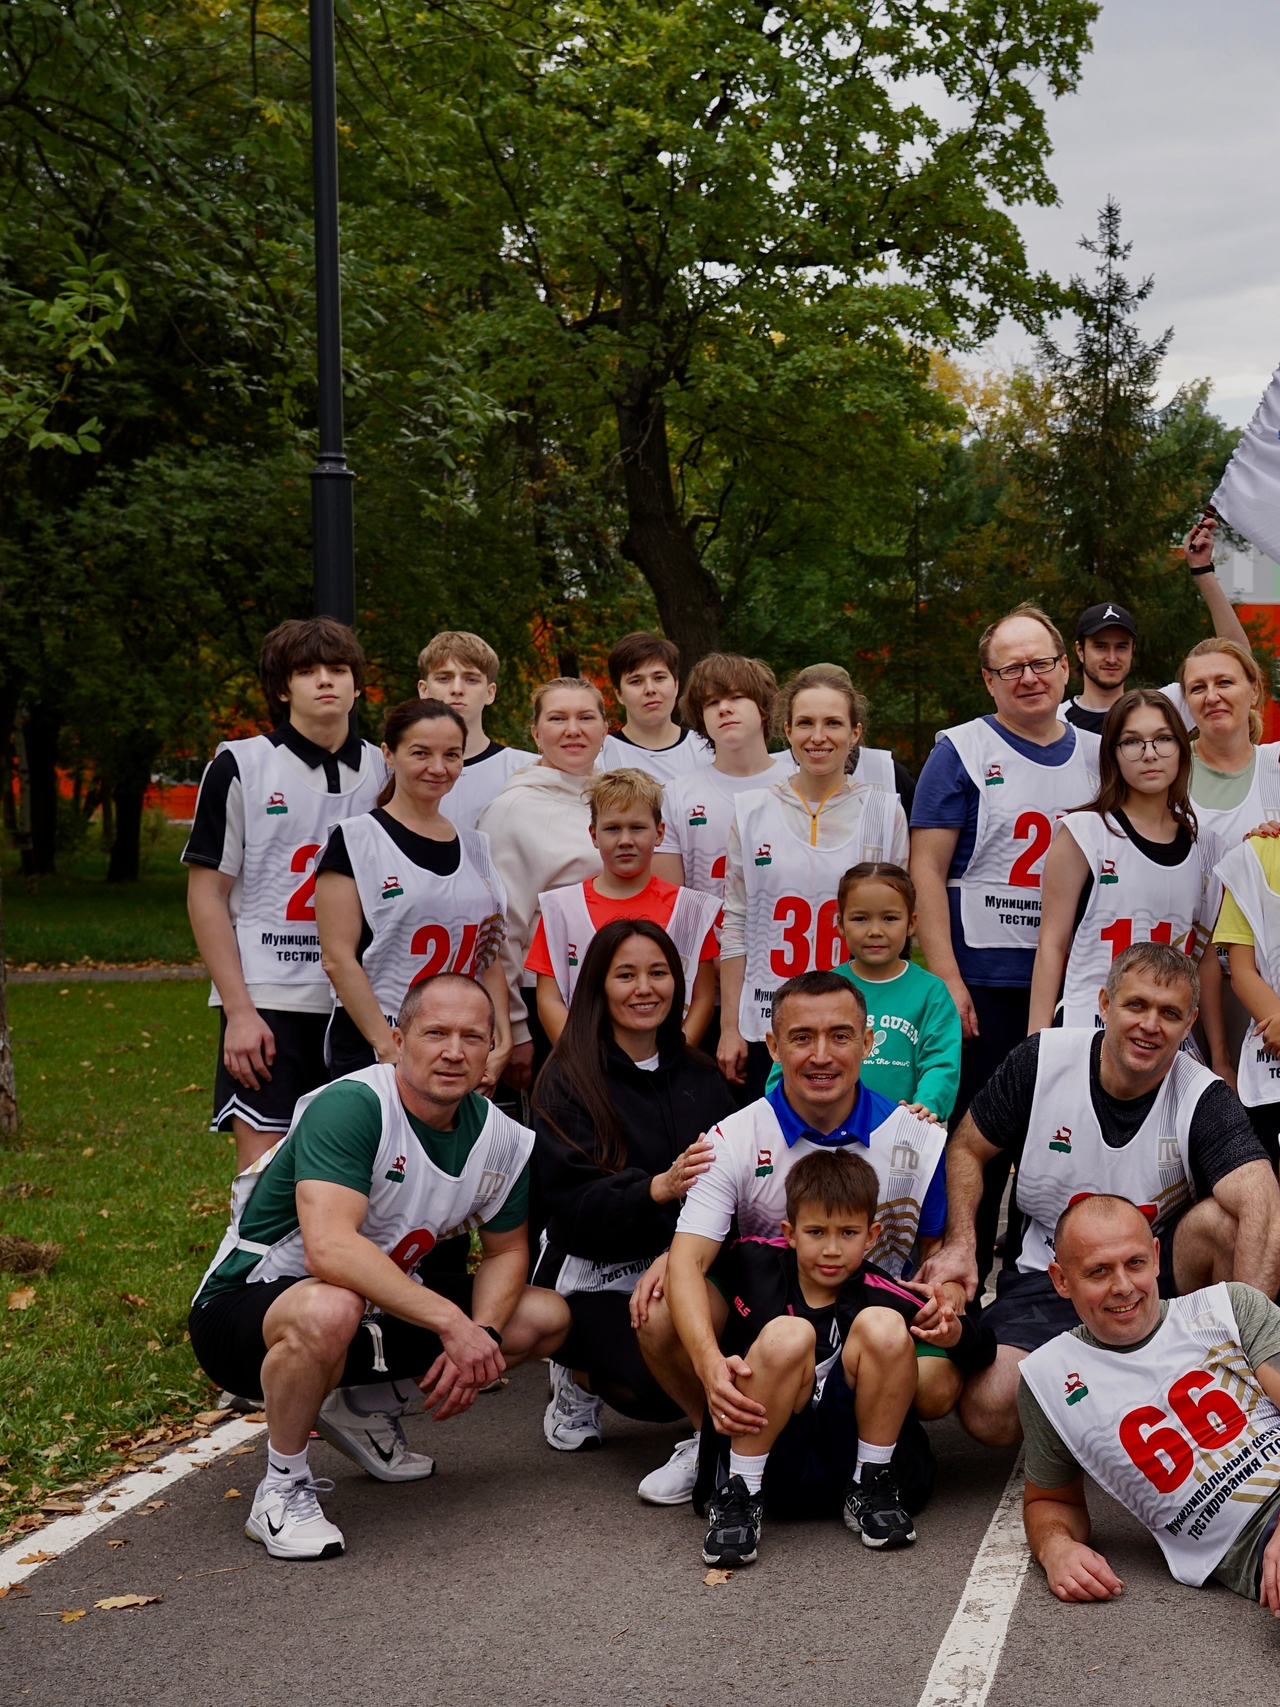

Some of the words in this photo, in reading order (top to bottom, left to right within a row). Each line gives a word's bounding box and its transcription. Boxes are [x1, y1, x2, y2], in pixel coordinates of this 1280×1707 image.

[1008, 811, 1065, 888] 2
[276, 951, 323, 963] тестир
[1119, 1370, 1248, 1494] 66
[1187, 1457, 1262, 1541] тестирования
